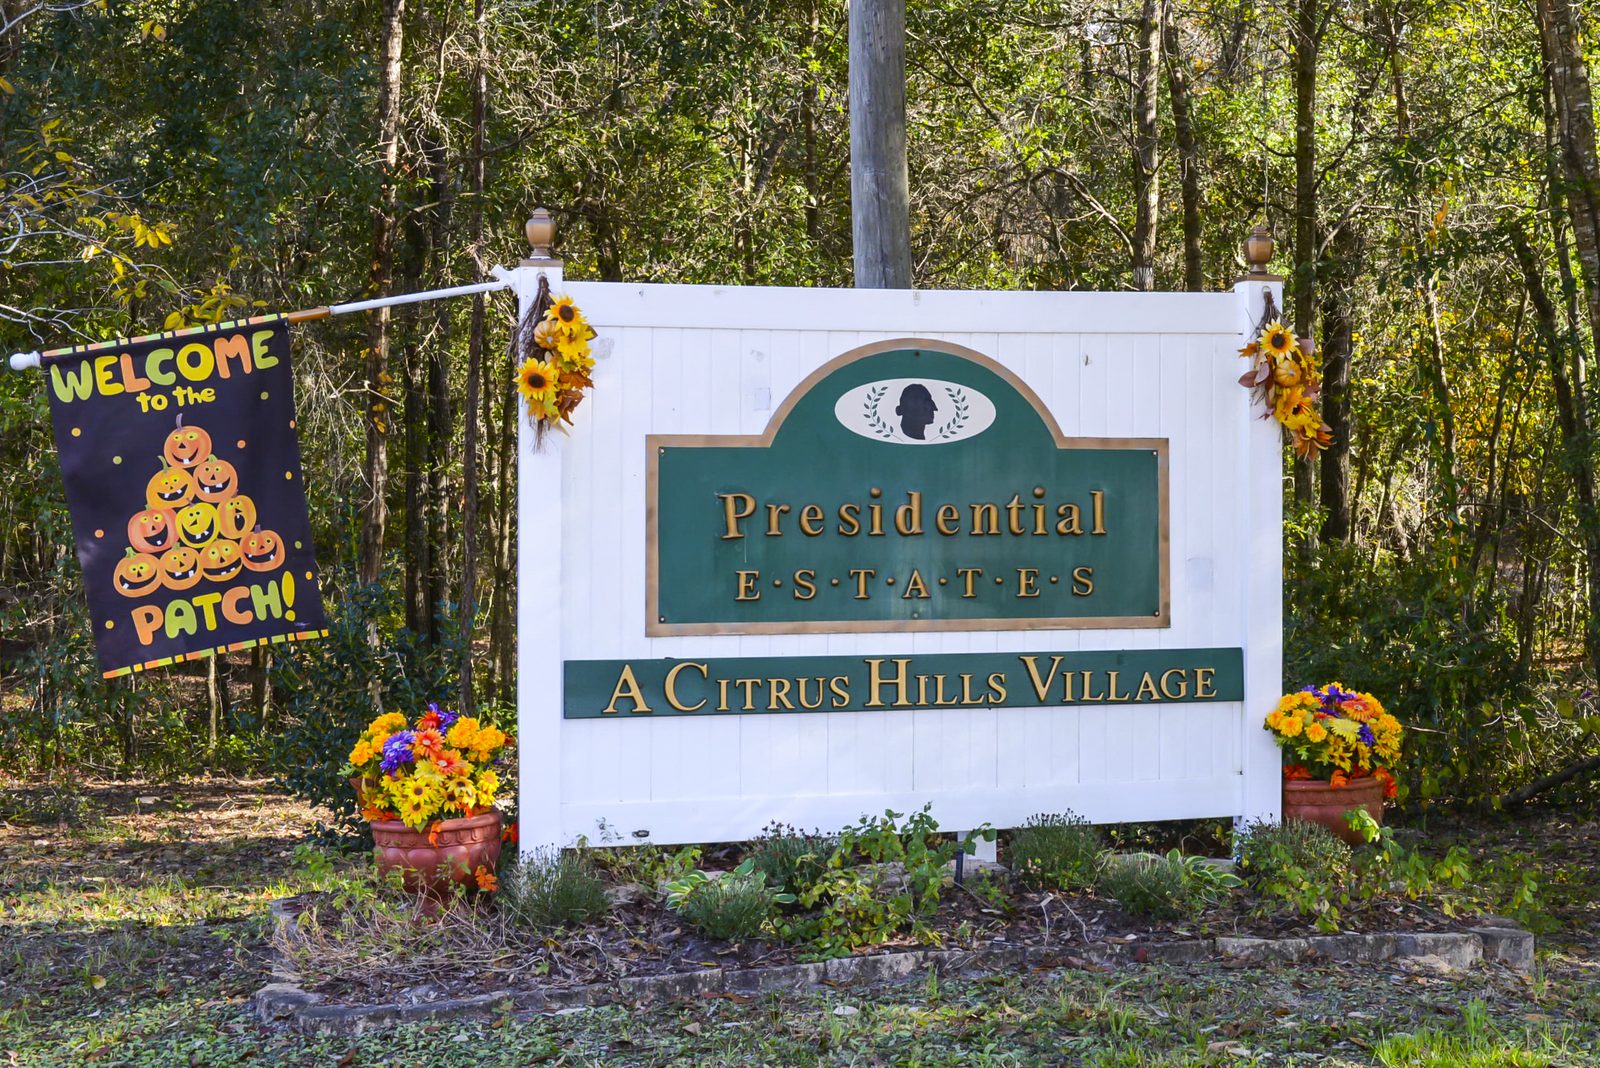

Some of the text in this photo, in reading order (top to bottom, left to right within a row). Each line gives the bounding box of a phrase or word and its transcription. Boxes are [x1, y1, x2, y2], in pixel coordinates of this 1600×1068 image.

[50, 330, 279, 403] WELCOME
[136, 386, 216, 413] to the
[720, 486, 1107, 539] Presidential
[131, 570, 296, 646] PATCH!
[602, 655, 1217, 714] A CITRUS HILLS VILLAGE
